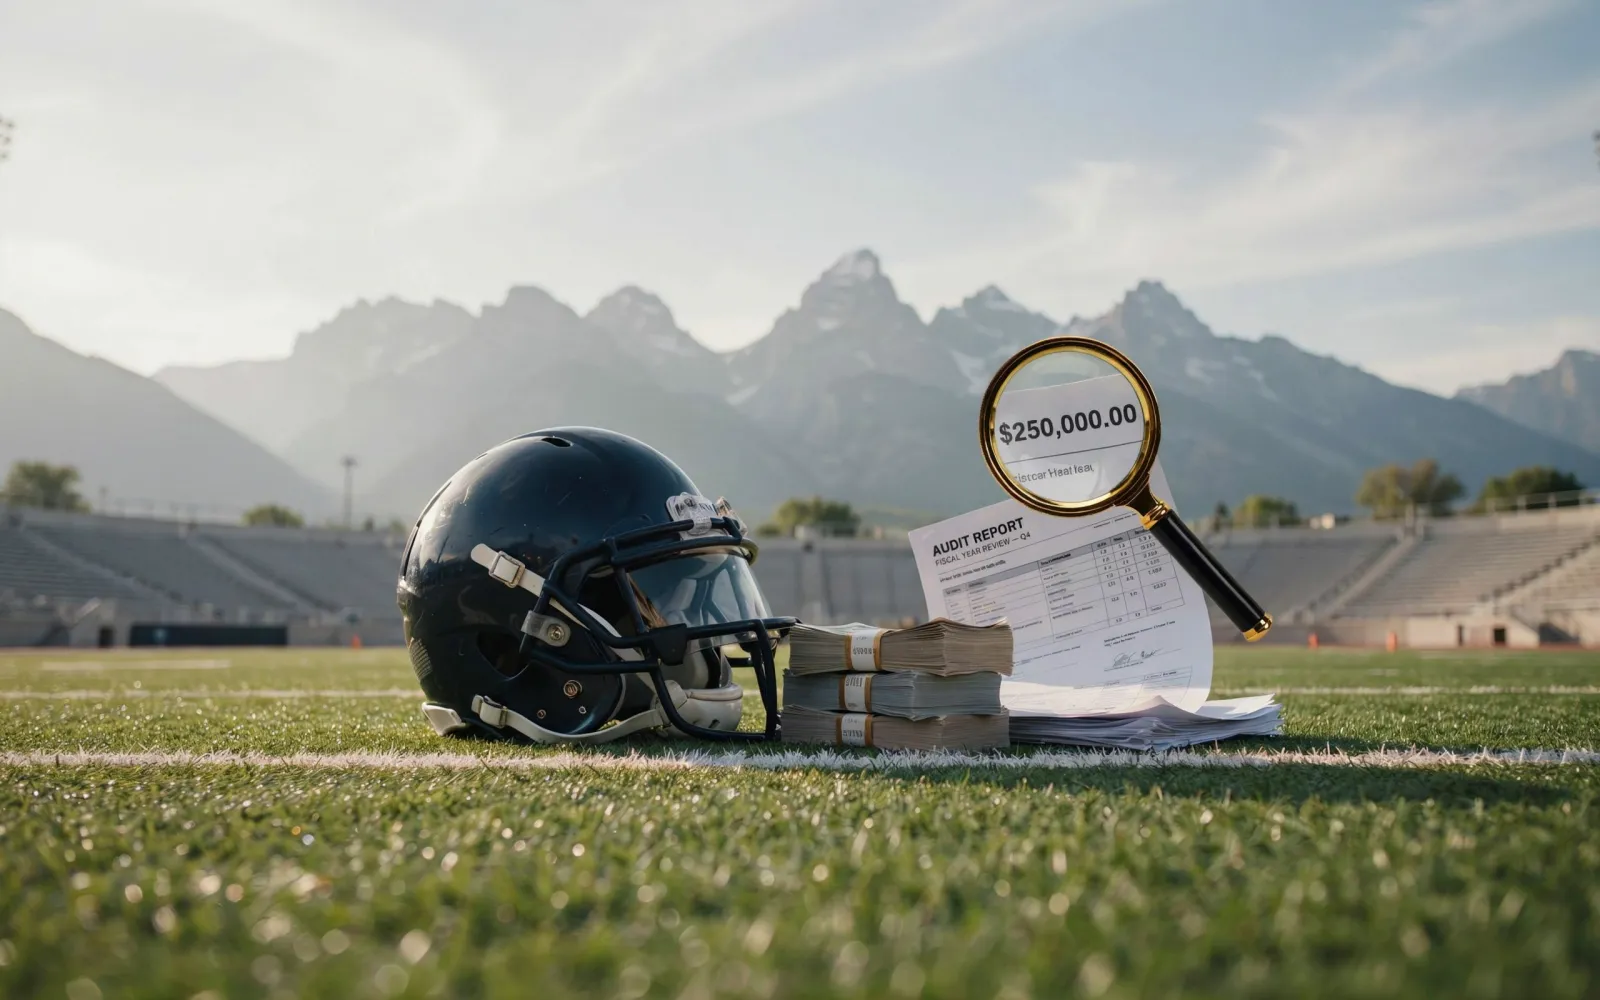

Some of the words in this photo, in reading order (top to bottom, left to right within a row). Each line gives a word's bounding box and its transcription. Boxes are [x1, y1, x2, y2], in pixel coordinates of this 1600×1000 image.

[999, 403, 1137, 446] $250,000.00
[933, 534, 970, 557] AUDIT
[972, 517, 1024, 544] REPORT
[934, 554, 961, 567] FISCAL
[961, 547, 982, 558] YEAR
[982, 537, 1011, 553] REVIEW
[1020, 531, 1031, 541] Q4
